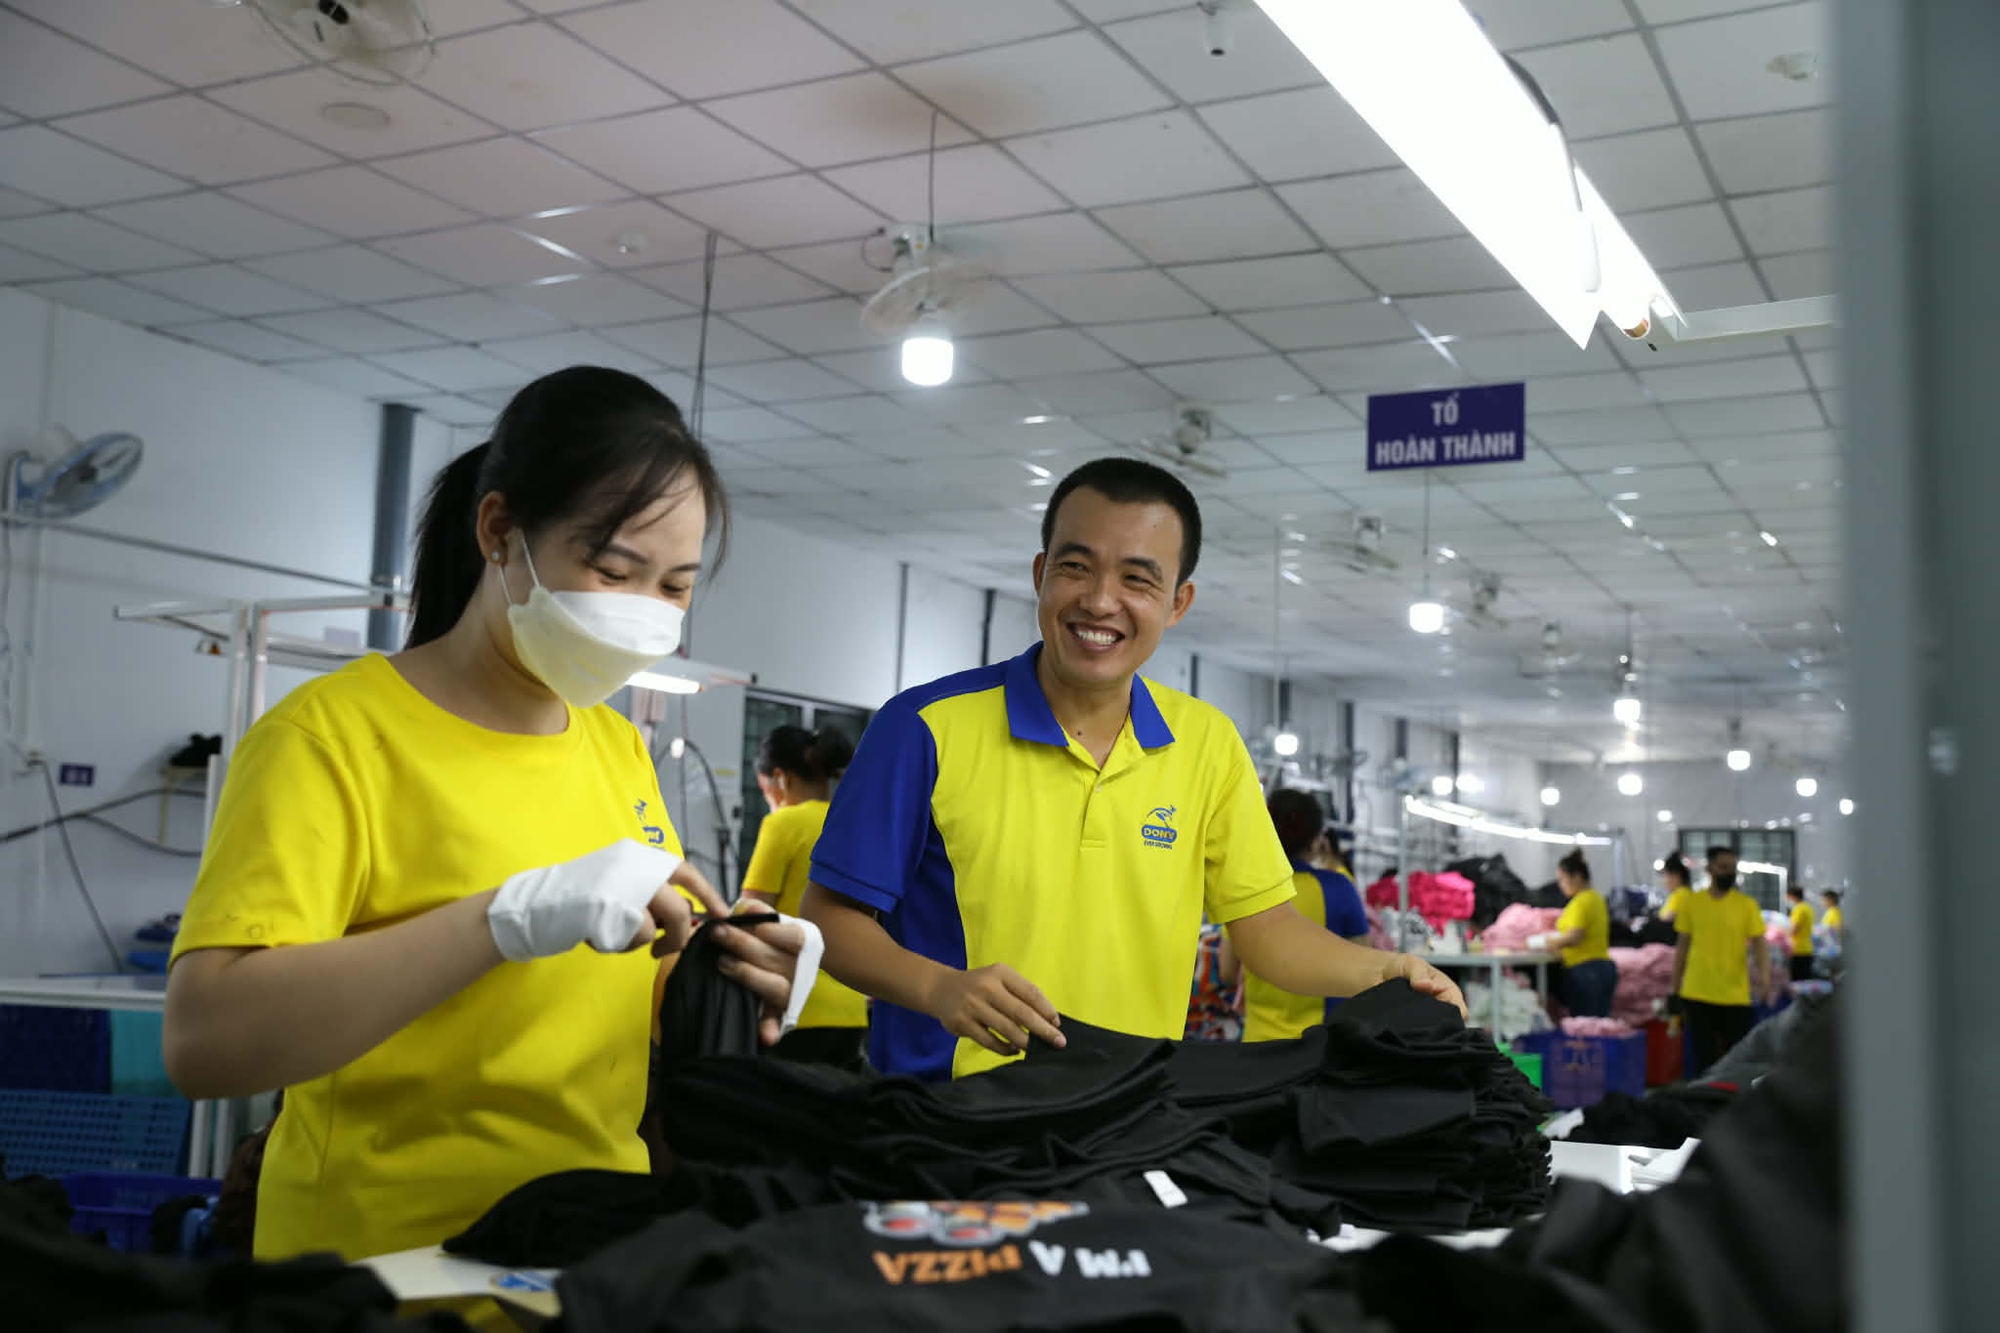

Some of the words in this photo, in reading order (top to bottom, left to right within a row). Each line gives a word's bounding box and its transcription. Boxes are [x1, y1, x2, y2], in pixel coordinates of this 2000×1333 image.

[1375, 434, 1436, 465] HOÀN
[1441, 430, 1516, 460] THÀNH
[1144, 827, 1175, 840] DONY
[873, 1245, 1022, 1284] PIZZA
[1028, 1240, 1066, 1276] A
